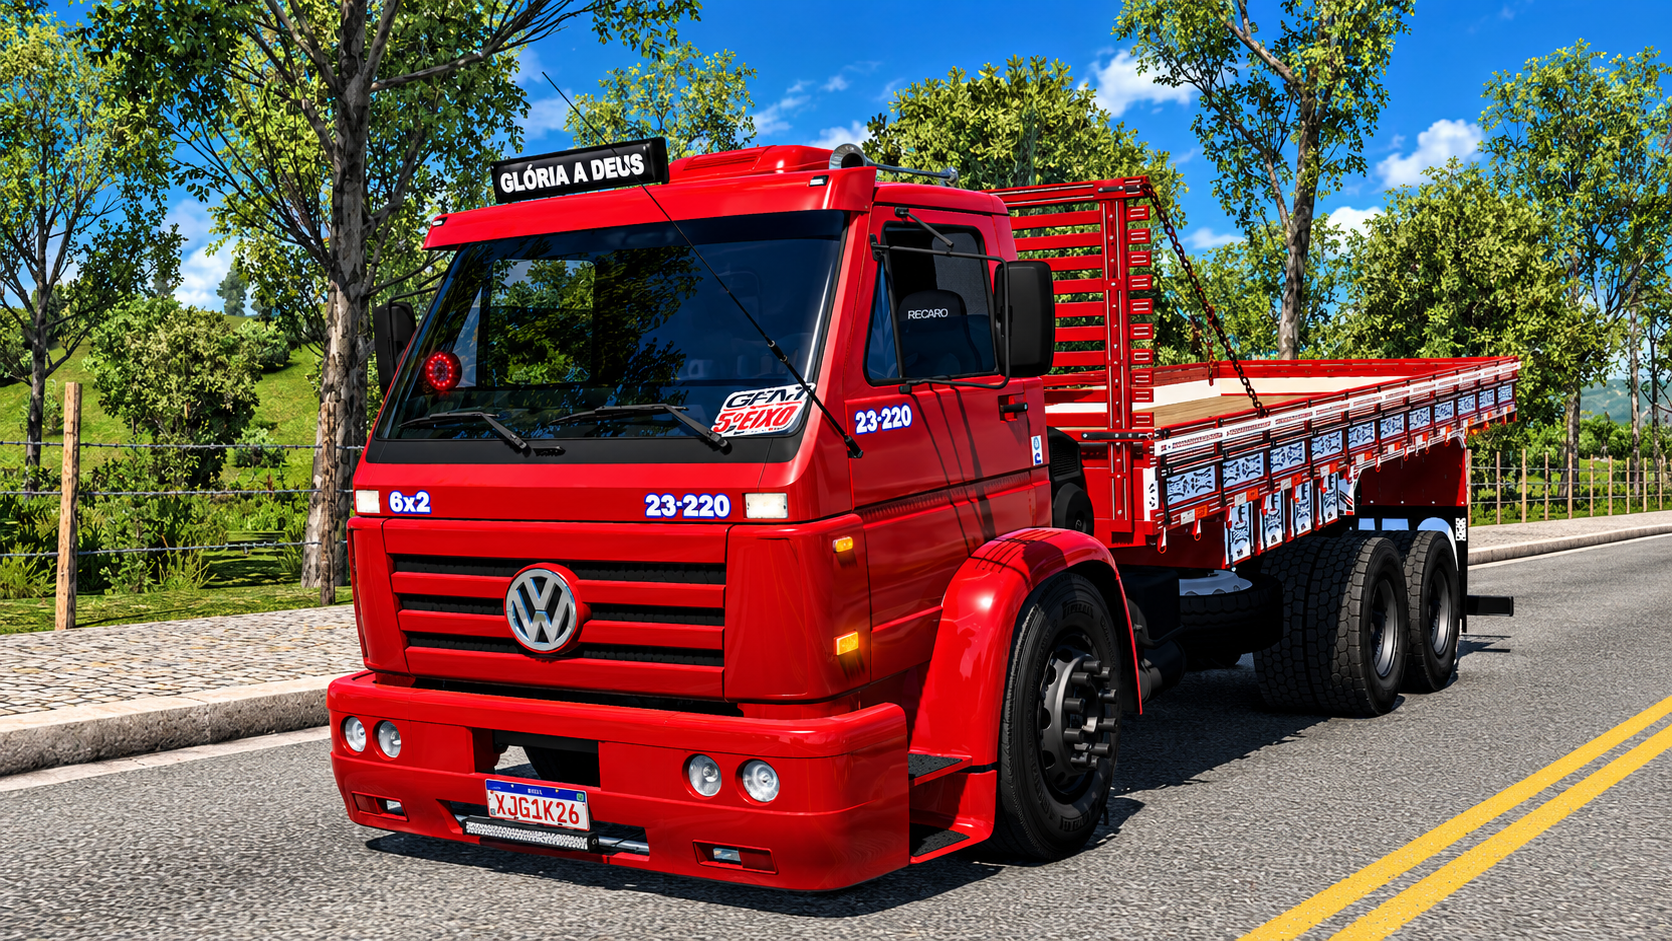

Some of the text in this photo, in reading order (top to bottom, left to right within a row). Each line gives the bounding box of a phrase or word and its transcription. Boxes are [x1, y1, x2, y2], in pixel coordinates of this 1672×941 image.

[500, 153, 645, 193] GLÓRIA A DEUS
[907, 308, 949, 320] RECARO
[389, 490, 432, 514] 6x2
[495, 793, 580, 825] XJG1K26
